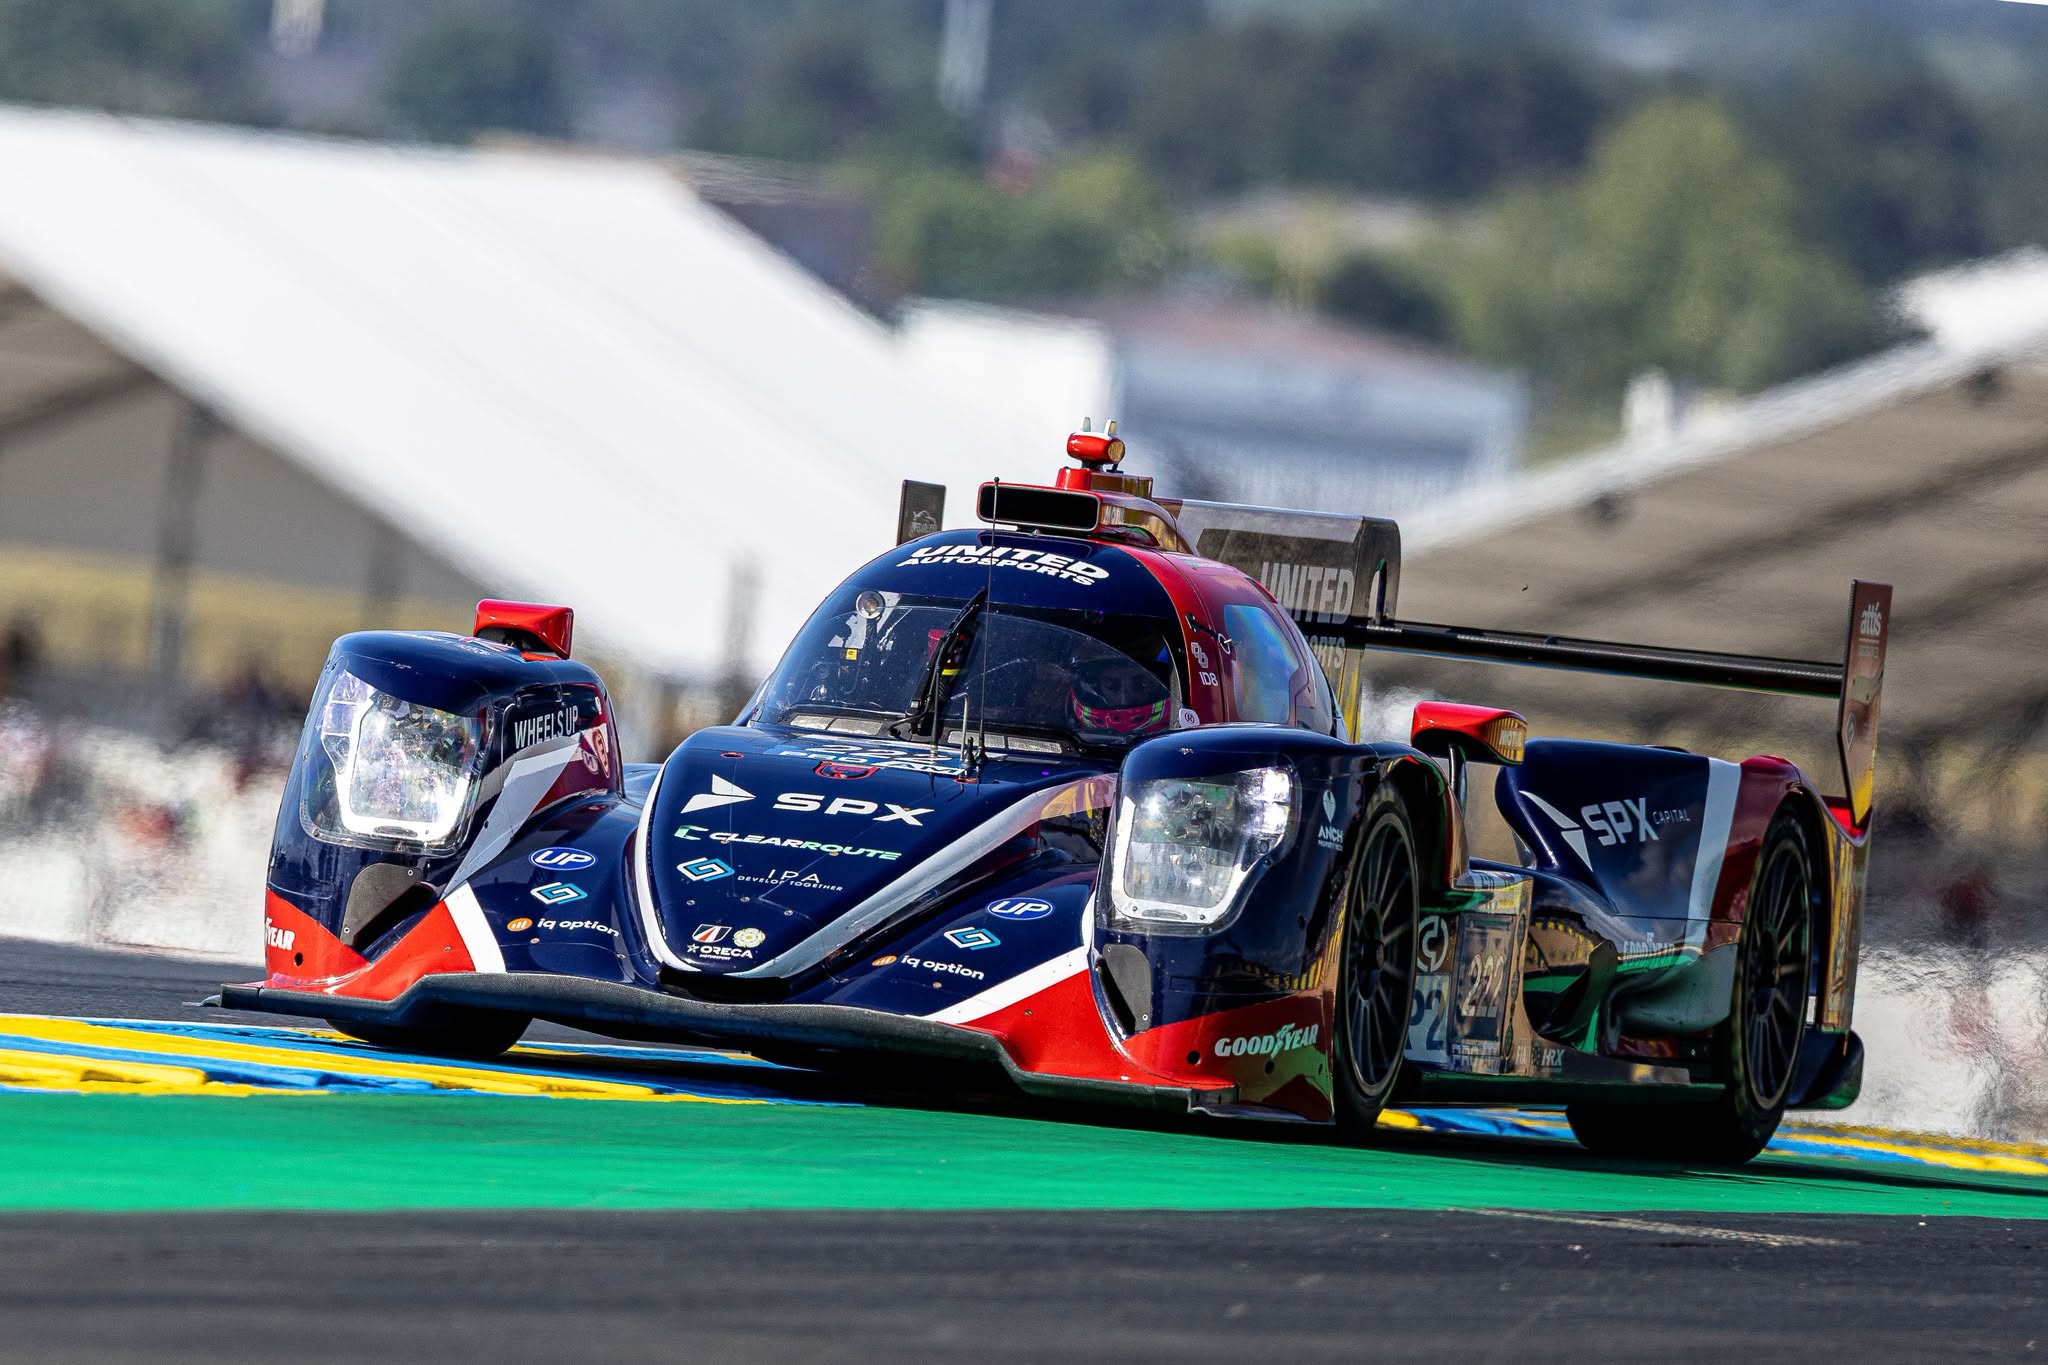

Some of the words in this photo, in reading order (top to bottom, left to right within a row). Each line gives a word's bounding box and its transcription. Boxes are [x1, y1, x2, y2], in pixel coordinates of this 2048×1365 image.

[896, 556, 1096, 586] AUTOSPORTS
[911, 544, 1110, 579] UNITED
[1261, 561, 1356, 625] UNITED
[514, 711, 564, 749] WHEELS
[565, 705, 579, 736] UP
[773, 792, 935, 827] SPX
[1580, 797, 1659, 847] SPX
[1652, 808, 1690, 825] CAPITAL
[535, 850, 594, 867] UP
[709, 831, 902, 861] CLEARROUTE
[737, 875, 785, 886] DEVELOP
[789, 881, 844, 892] TOGETHER
[767, 869, 821, 884] IPA
[993, 900, 1050, 918] UP
[537, 918, 557, 930] iq
[559, 919, 620, 938] option
[700, 945, 753, 959] ORECA
[901, 954, 921, 968] iq
[923, 957, 985, 981] option
[1461, 953, 1504, 1018] 222
[1214, 1022, 1319, 1058] GOODYEAR
